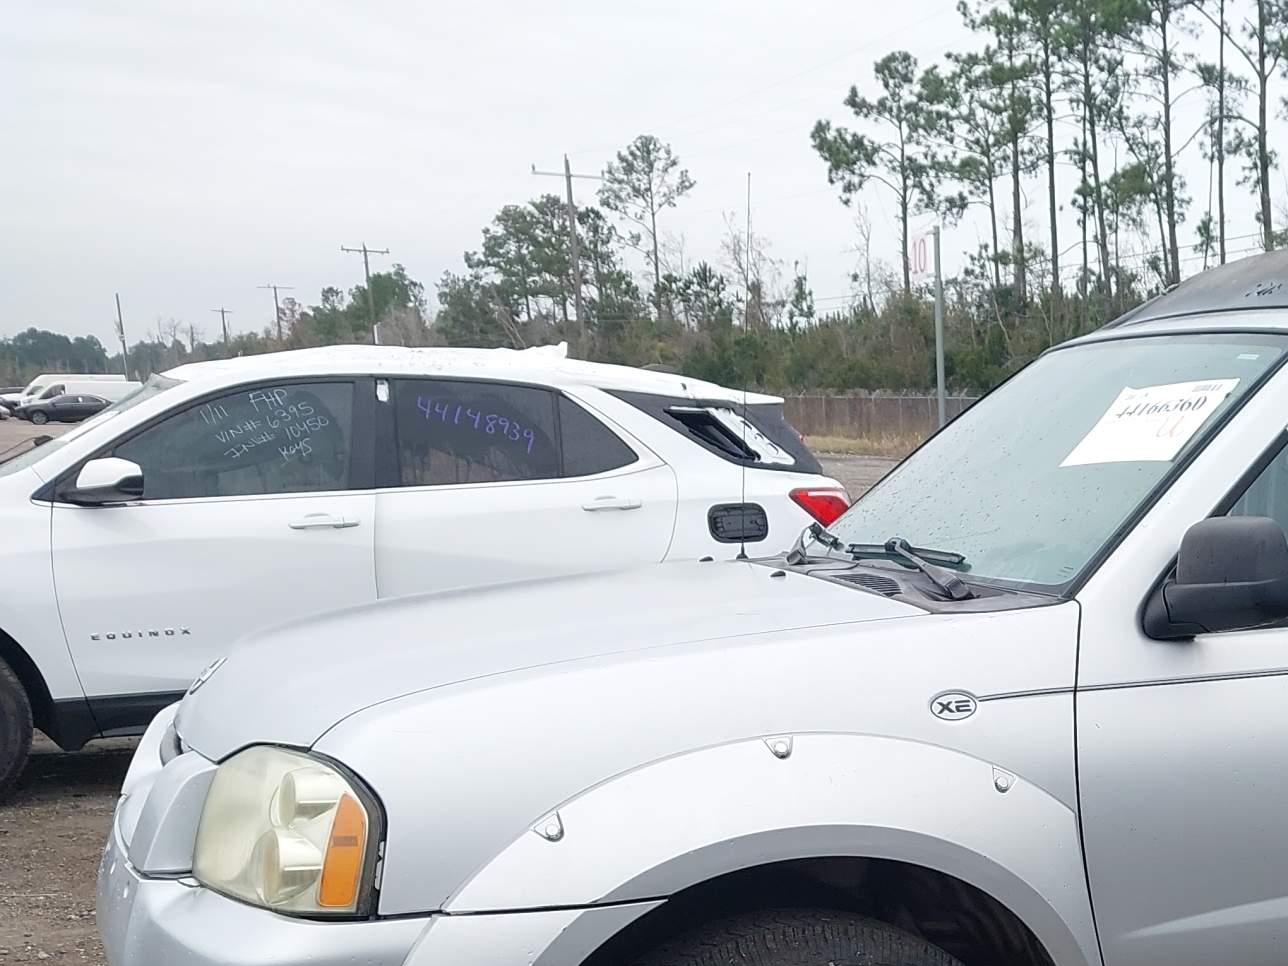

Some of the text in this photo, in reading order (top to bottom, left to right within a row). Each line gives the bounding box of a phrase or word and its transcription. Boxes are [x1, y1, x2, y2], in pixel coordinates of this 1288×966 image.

[248, 388, 289, 413] FHP
[266, 401, 315, 429] 6395
[416, 395, 535, 455] 44148939
[90, 626, 192, 641] EQUINOX
[936, 699, 972, 715] XE
